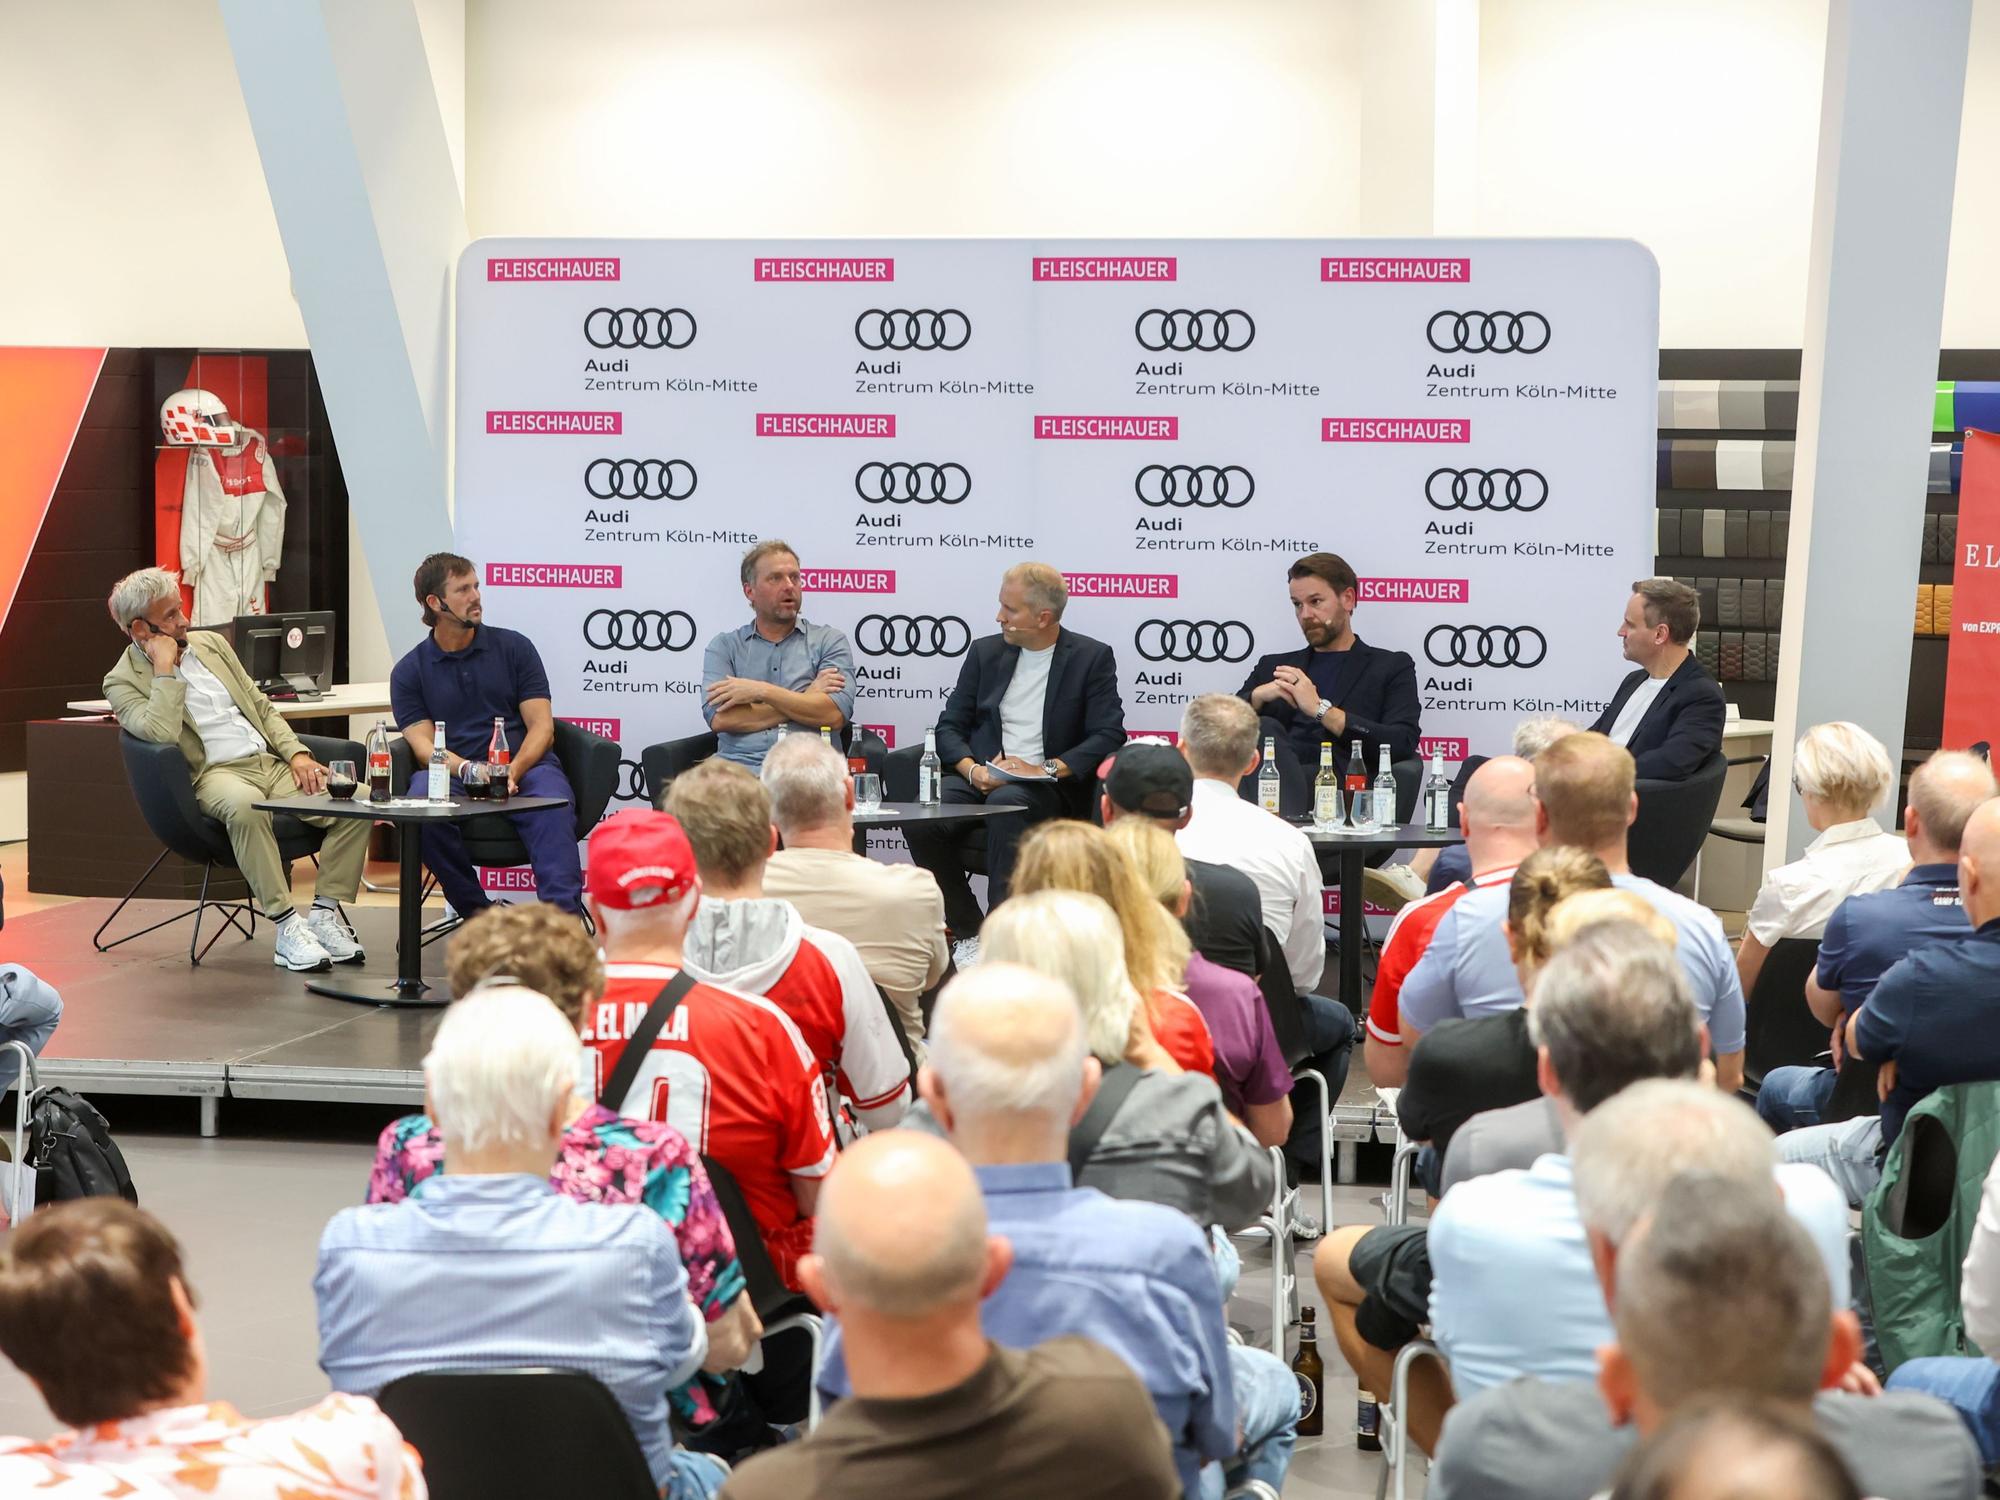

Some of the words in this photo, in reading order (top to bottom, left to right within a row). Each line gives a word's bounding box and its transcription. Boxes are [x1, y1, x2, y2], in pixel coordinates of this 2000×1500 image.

[495, 262, 614, 277] FLEISCHHAUER
[762, 262, 886, 278] FLEISCHHAUER
[1041, 262, 1169, 277] FLEISCHHAUER
[1329, 262, 1461, 278] FLEISCHHAUER
[585, 359, 628, 373] Audi
[856, 361, 900, 375] Audi
[1136, 362, 1182, 376] Audi
[1427, 364, 1475, 378] Audi
[585, 378, 660, 391] Zentrum
[667, 379, 758, 393] Köln-Mitte
[856, 381, 933, 394] Zentrum
[940, 381, 1034, 395] Köln-Mitte
[1136, 382, 1215, 395] Zentrum
[1223, 383, 1319, 396] Köln-Mitte
[1427, 384, 1508, 398] Zentrum
[1517, 385, 1617, 400] Köln-Mitte
[493, 415, 614, 431] FLEISCHHAUER
[763, 418, 887, 434] FLEISCHHAUER
[1043, 420, 1169, 436] FLEISCHHAUER
[1330, 422, 1461, 438] FLEISCHHAUER
[585, 510, 628, 523] Audi
[856, 514, 900, 527] Audi
[1135, 517, 1182, 531] Audi
[1425, 521, 1473, 535] Audi
[585, 529, 660, 542] Zentrum
[667, 530, 758, 545] Köln-Mitte
[856, 533, 933, 546] Zentrum
[940, 534, 1034, 548] Köln-Mitte
[1136, 537, 1215, 550] Zentrum
[1222, 538, 1319, 553] Köln-Mitte
[1425, 541, 1507, 555] Zentrum
[1515, 543, 1615, 557] Köln-Mitte
[1985, 544, 2000, 568] L
[493, 567, 614, 584] FLEISCHHAUER
[800, 572, 887, 590] SCHHAUER
[1064, 576, 1169, 594] EISCHHAUER
[1359, 581, 1460, 599] ISCHHAUER
[1962, 622, 1978, 632] von
[583, 660, 628, 673] Audi
[855, 666, 901, 679] Audi
[583, 679, 658, 692] Zentrum
[1135, 672, 1182, 685] Audi
[1424, 677, 1472, 691] Audi
[856, 685, 933, 699] Zentrum
[1136, 690, 1197, 704] Zentr
[1424, 697, 1506, 711] Zentrum
[1514, 699, 1610, 713] Köln-Mitte
[866, 838, 909, 850] entru
